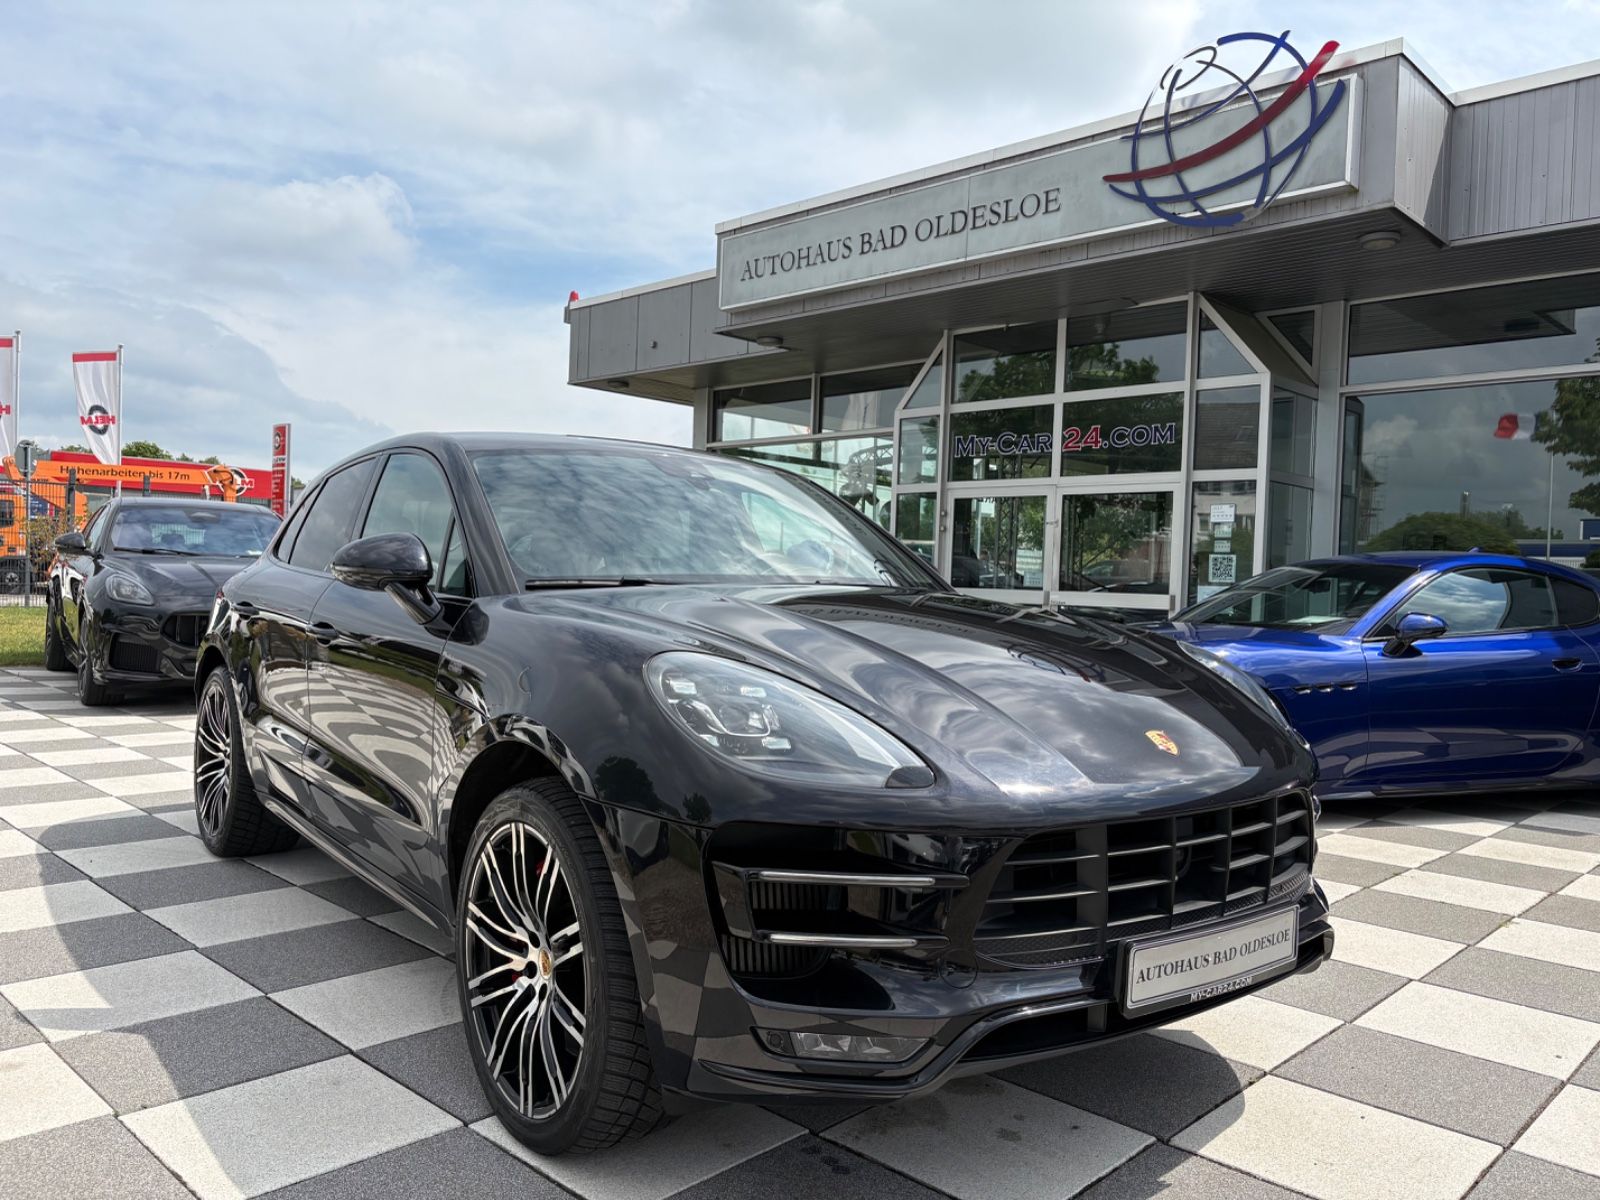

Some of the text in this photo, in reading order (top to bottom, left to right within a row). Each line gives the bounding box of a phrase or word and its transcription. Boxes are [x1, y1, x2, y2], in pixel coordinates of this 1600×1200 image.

[741, 187, 1062, 282] AUTOHAUS BAD OLDESLOE
[60, 465, 190, 481] Hhenarbeiten bis 17m
[1136, 928, 1291, 984] AUTOHAUS BAD OLDESLOE
